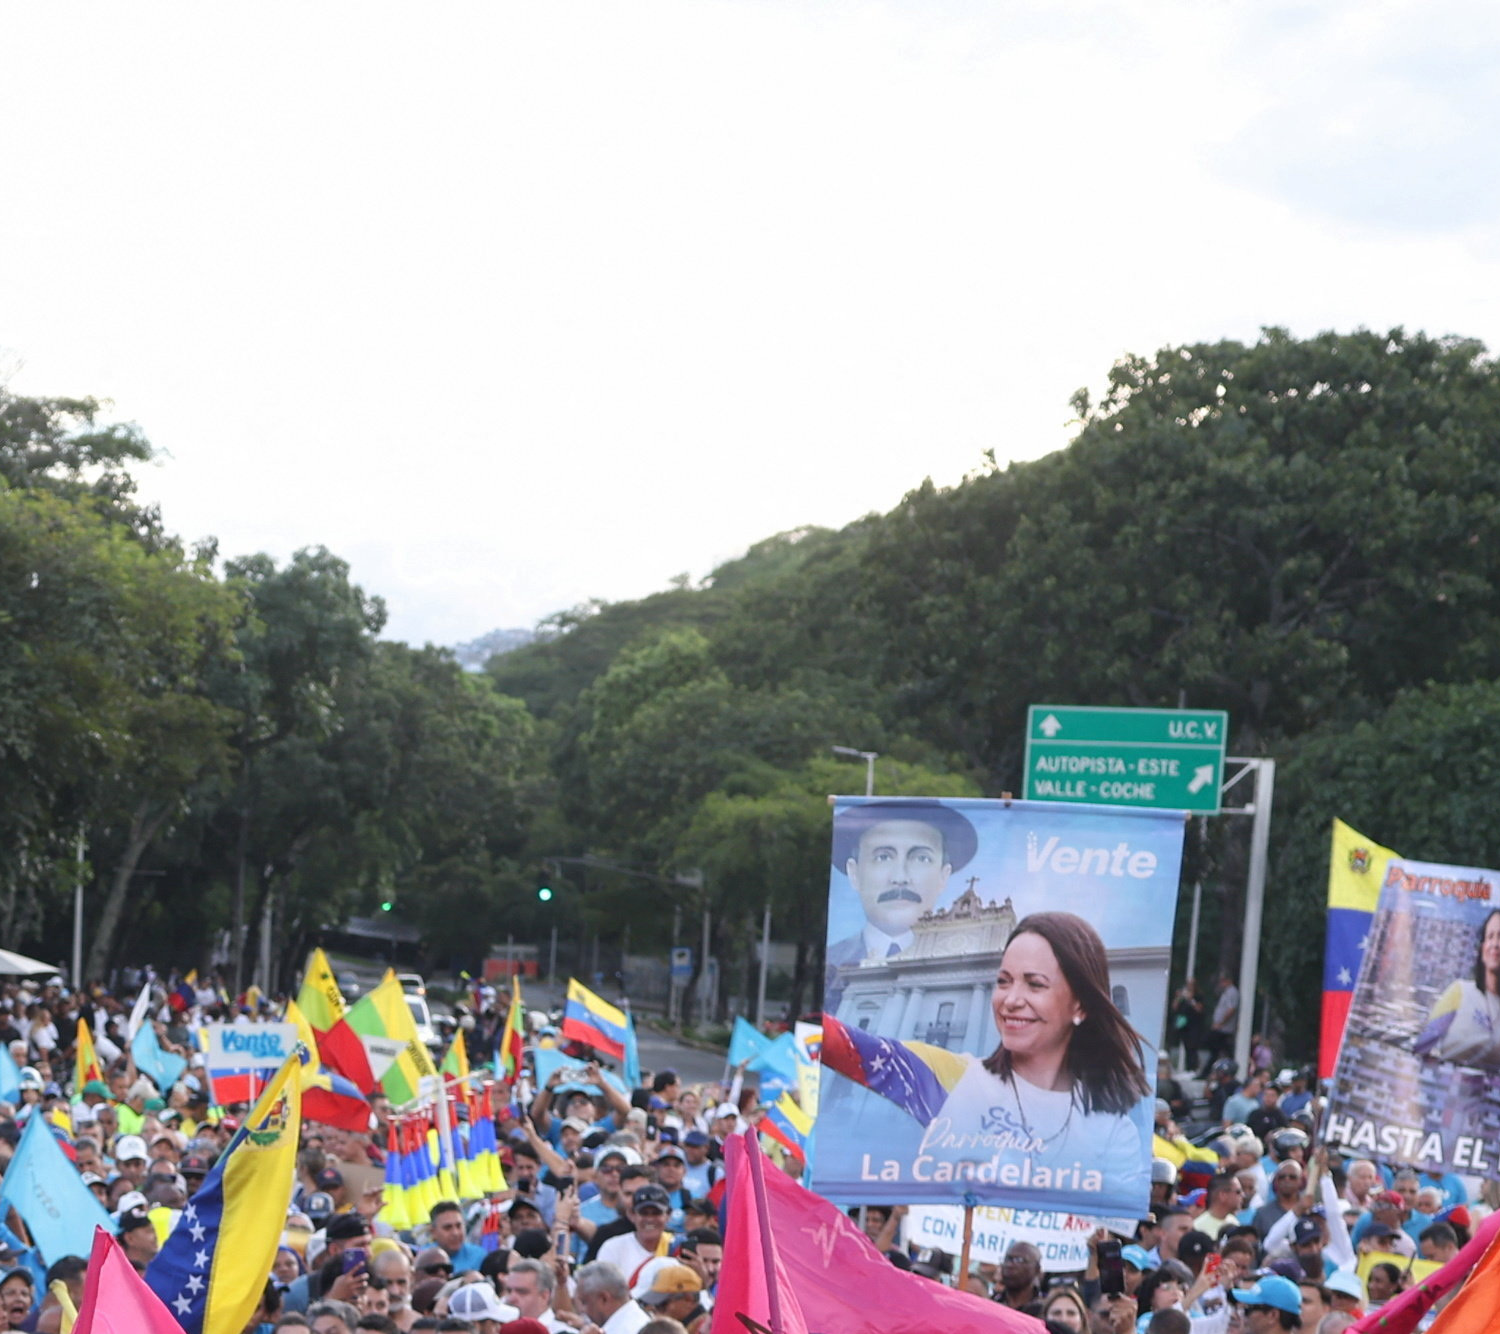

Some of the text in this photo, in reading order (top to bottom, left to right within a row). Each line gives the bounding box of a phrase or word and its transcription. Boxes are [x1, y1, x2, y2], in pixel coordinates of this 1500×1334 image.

[1034, 755, 1181, 777] AUTOPISTA ESTE
[1034, 779, 1156, 800] VALLE COCHE
[1027, 831, 1158, 880] Vente
[220, 1030, 283, 1054] Vente
[1325, 1111, 1443, 1162] HASTA
[1452, 1136, 1490, 1169] EL
[861, 1152, 1103, 1194] La Candelaria
